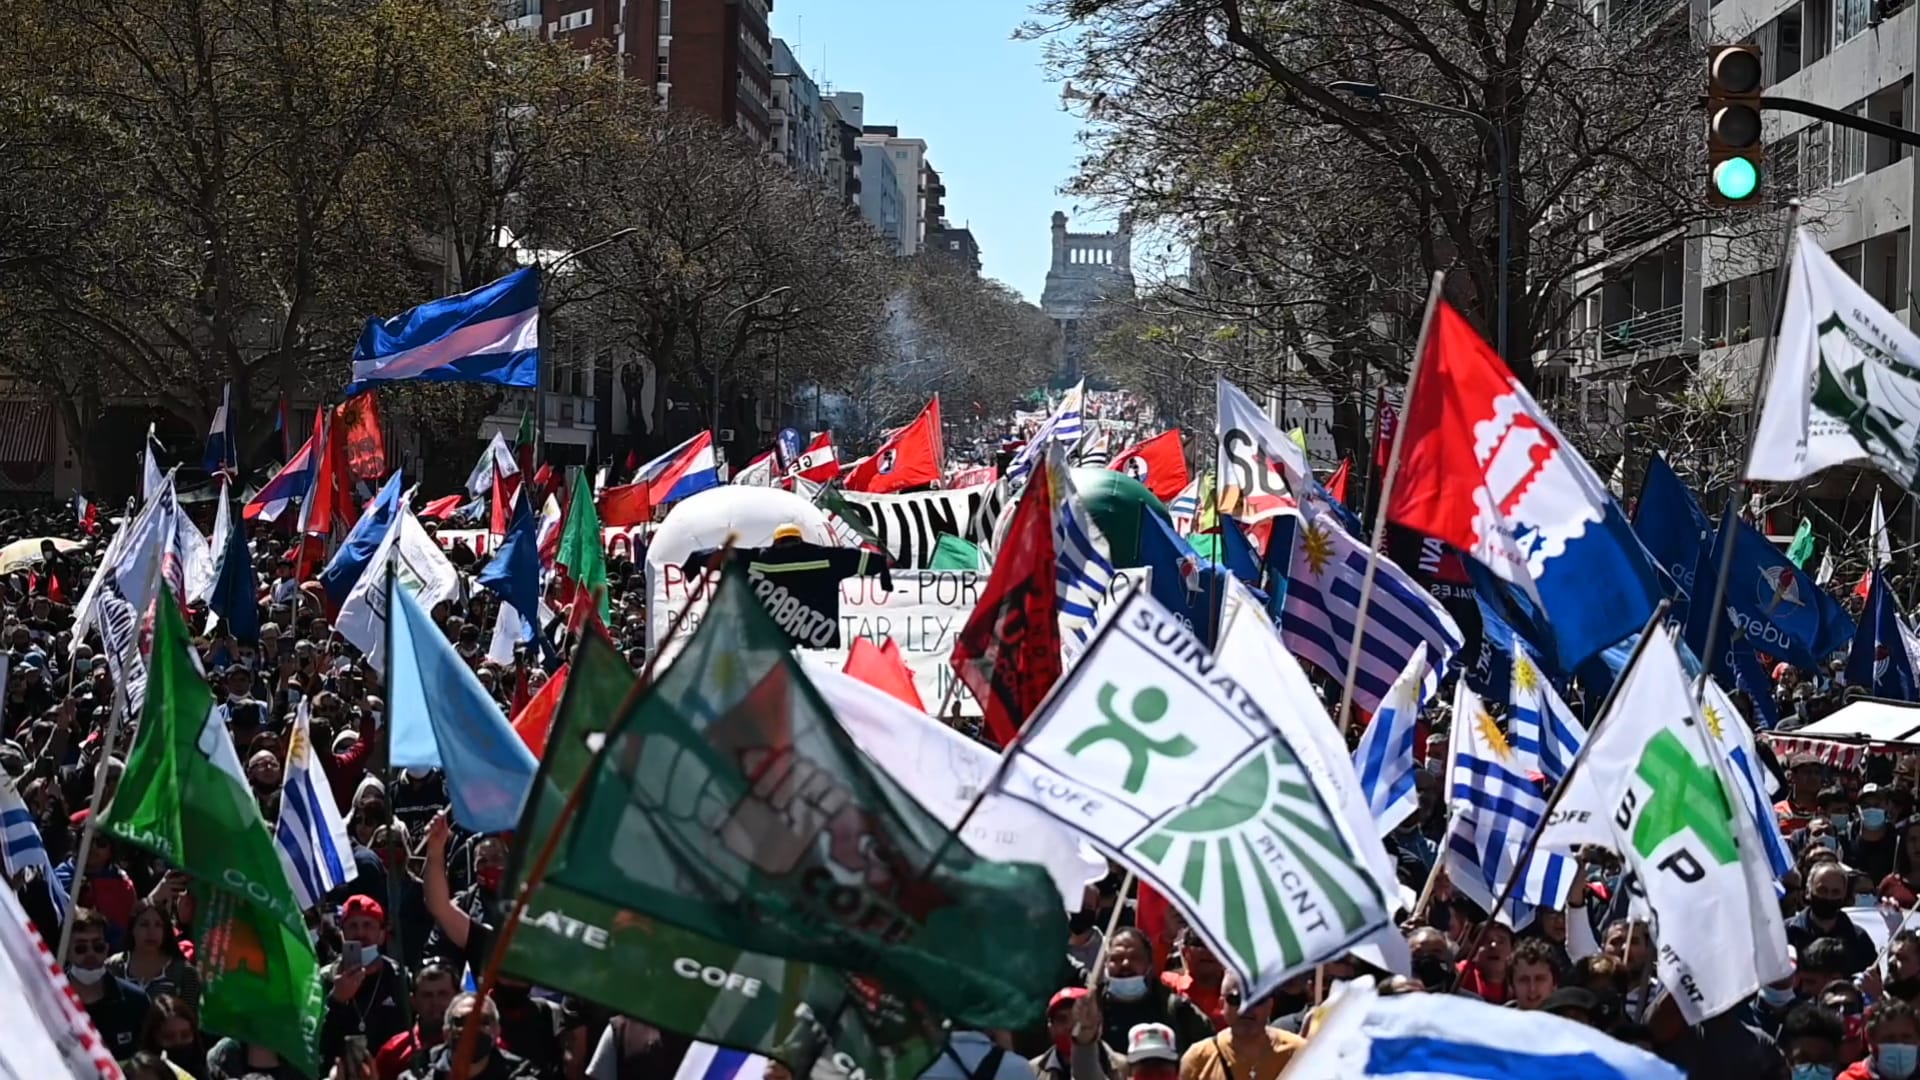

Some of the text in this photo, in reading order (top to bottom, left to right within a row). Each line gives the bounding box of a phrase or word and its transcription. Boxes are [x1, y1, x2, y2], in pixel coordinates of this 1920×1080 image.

[747, 567, 836, 647] TRABAJO
[918, 571, 978, 606] POR
[906, 615, 953, 652] LEY
[1031, 774, 1105, 817] COFE
[673, 956, 762, 999] COFE
[1680, 973, 1705, 1002] CNT
